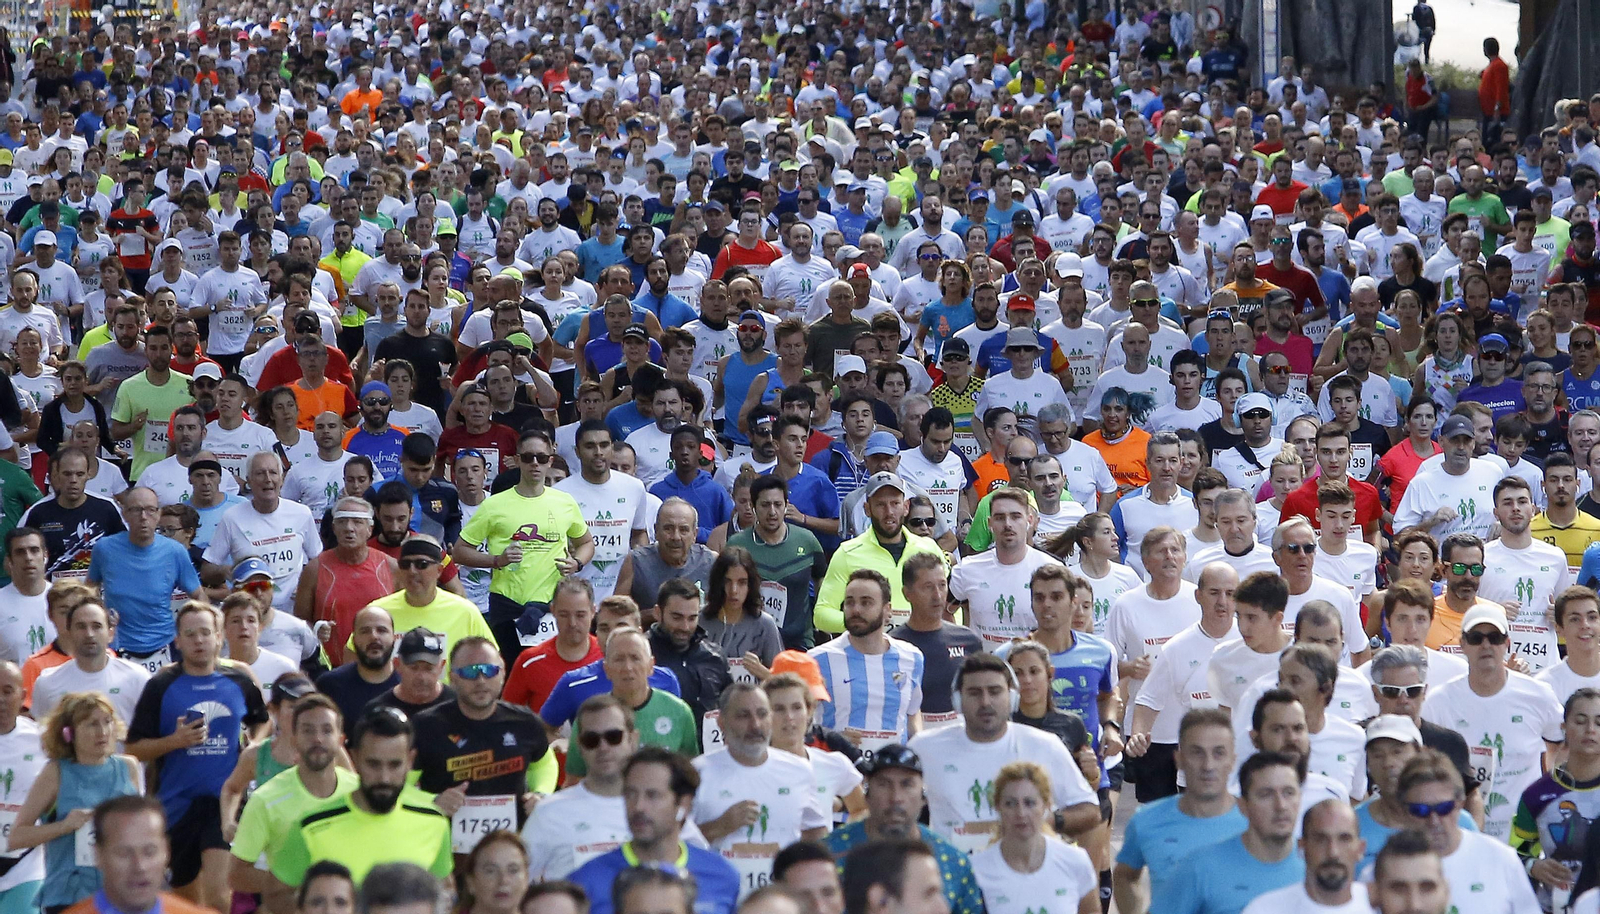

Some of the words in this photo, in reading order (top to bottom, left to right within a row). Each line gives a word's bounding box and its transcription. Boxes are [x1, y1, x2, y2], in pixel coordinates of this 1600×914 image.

[1054, 240, 1073, 248] 6002
[193, 253, 211, 261] 1252
[224, 316, 244, 324] 3625
[1305, 326, 1326, 335] 3697
[107, 364, 140, 372] Reebok
[936, 503, 953, 513] 36
[593, 535, 621, 546] 3741
[262, 550, 293, 564] 3740
[459, 819, 511, 834] 17522
[747, 873, 774, 888] 16
